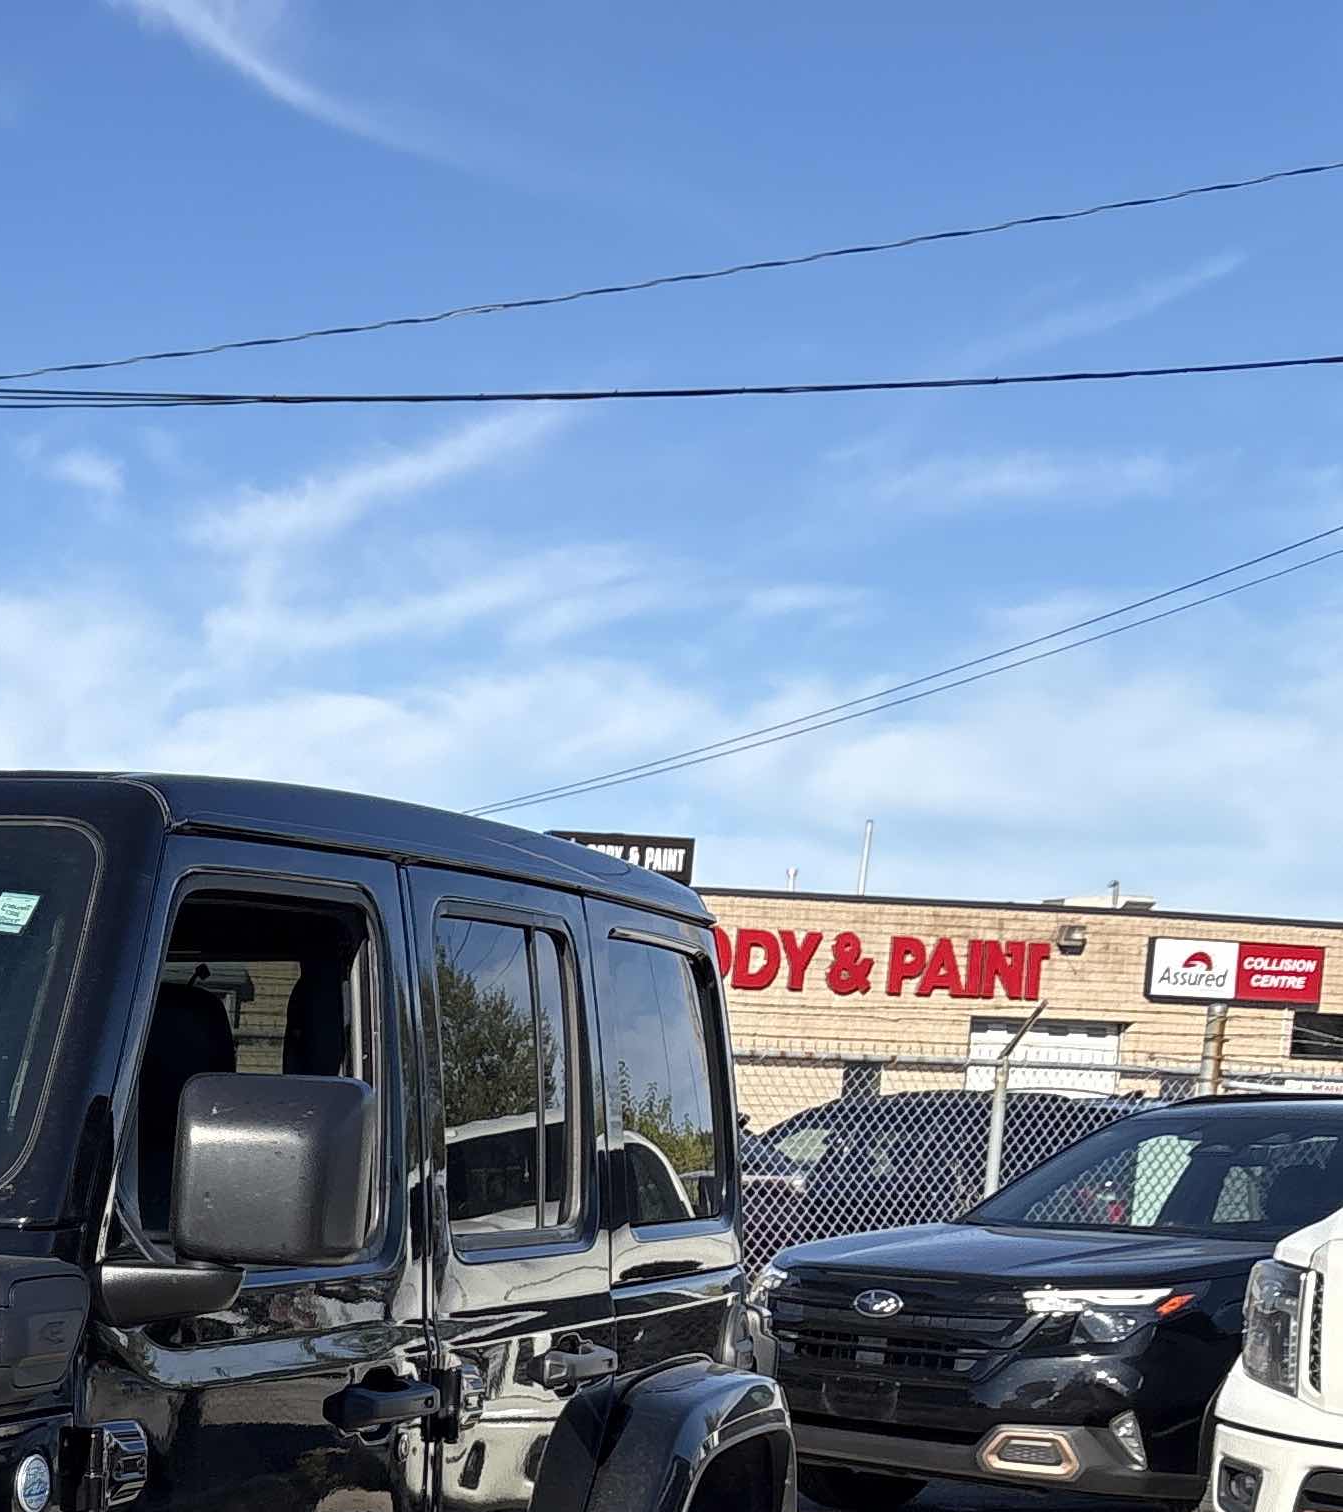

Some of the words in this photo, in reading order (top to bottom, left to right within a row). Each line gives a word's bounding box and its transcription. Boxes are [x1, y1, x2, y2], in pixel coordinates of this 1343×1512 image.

[628, 845, 640, 865] &
[645, 846, 686, 872] PAINT
[825, 931, 875, 996] &
[886, 935, 1051, 1000] PAINT
[1242, 956, 1317, 974] COLLISION
[1158, 967, 1229, 988] Assured
[1249, 973, 1308, 990] CENTRE
